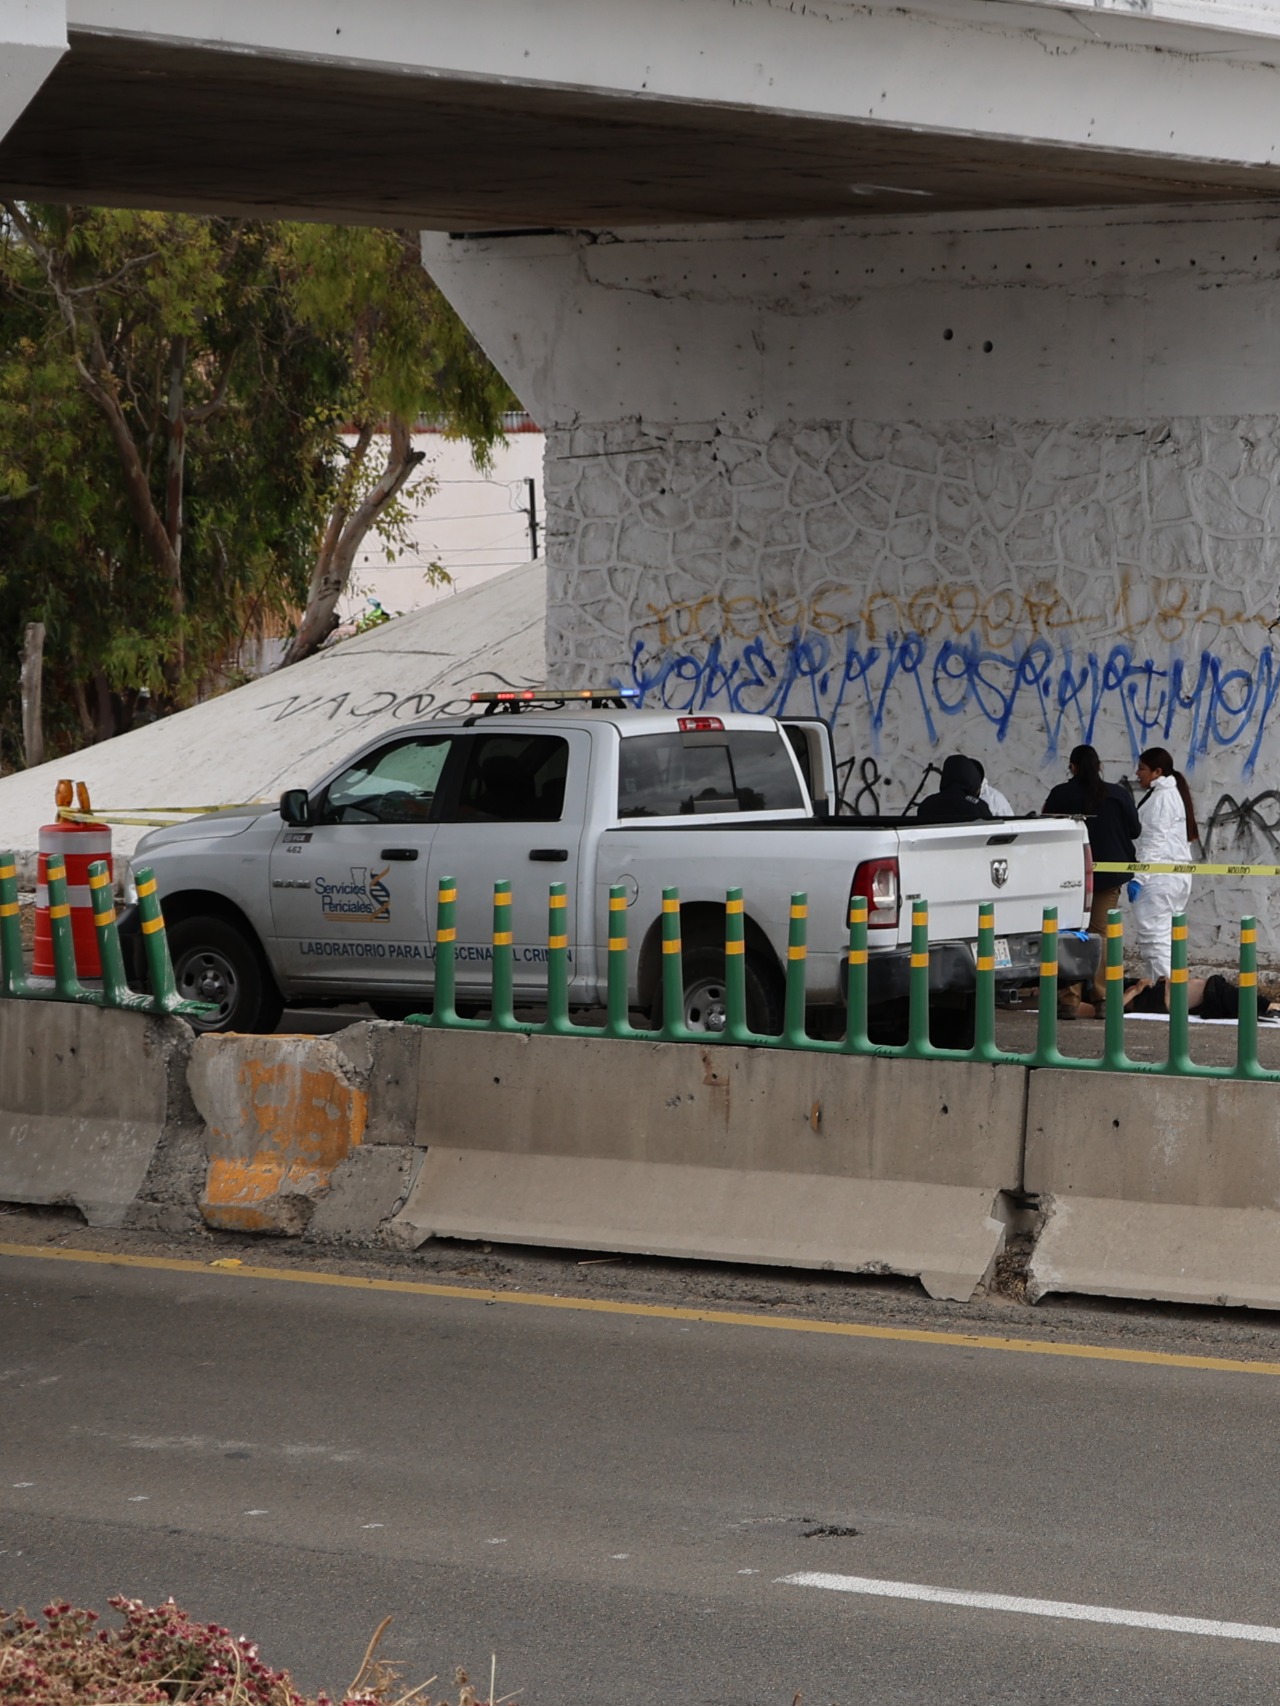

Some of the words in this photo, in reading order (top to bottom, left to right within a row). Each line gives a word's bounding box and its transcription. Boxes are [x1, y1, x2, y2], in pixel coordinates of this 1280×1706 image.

[1227, 866, 1251, 874] CAUTION
[315, 877, 366, 895] Servicios
[322, 895, 372, 913] Periciales
[299, 942, 386, 957] LABORATORIO
[388, 944, 422, 958] PARA
[454, 946, 492, 960] SCENA
[523, 949, 572, 962] CRIN
